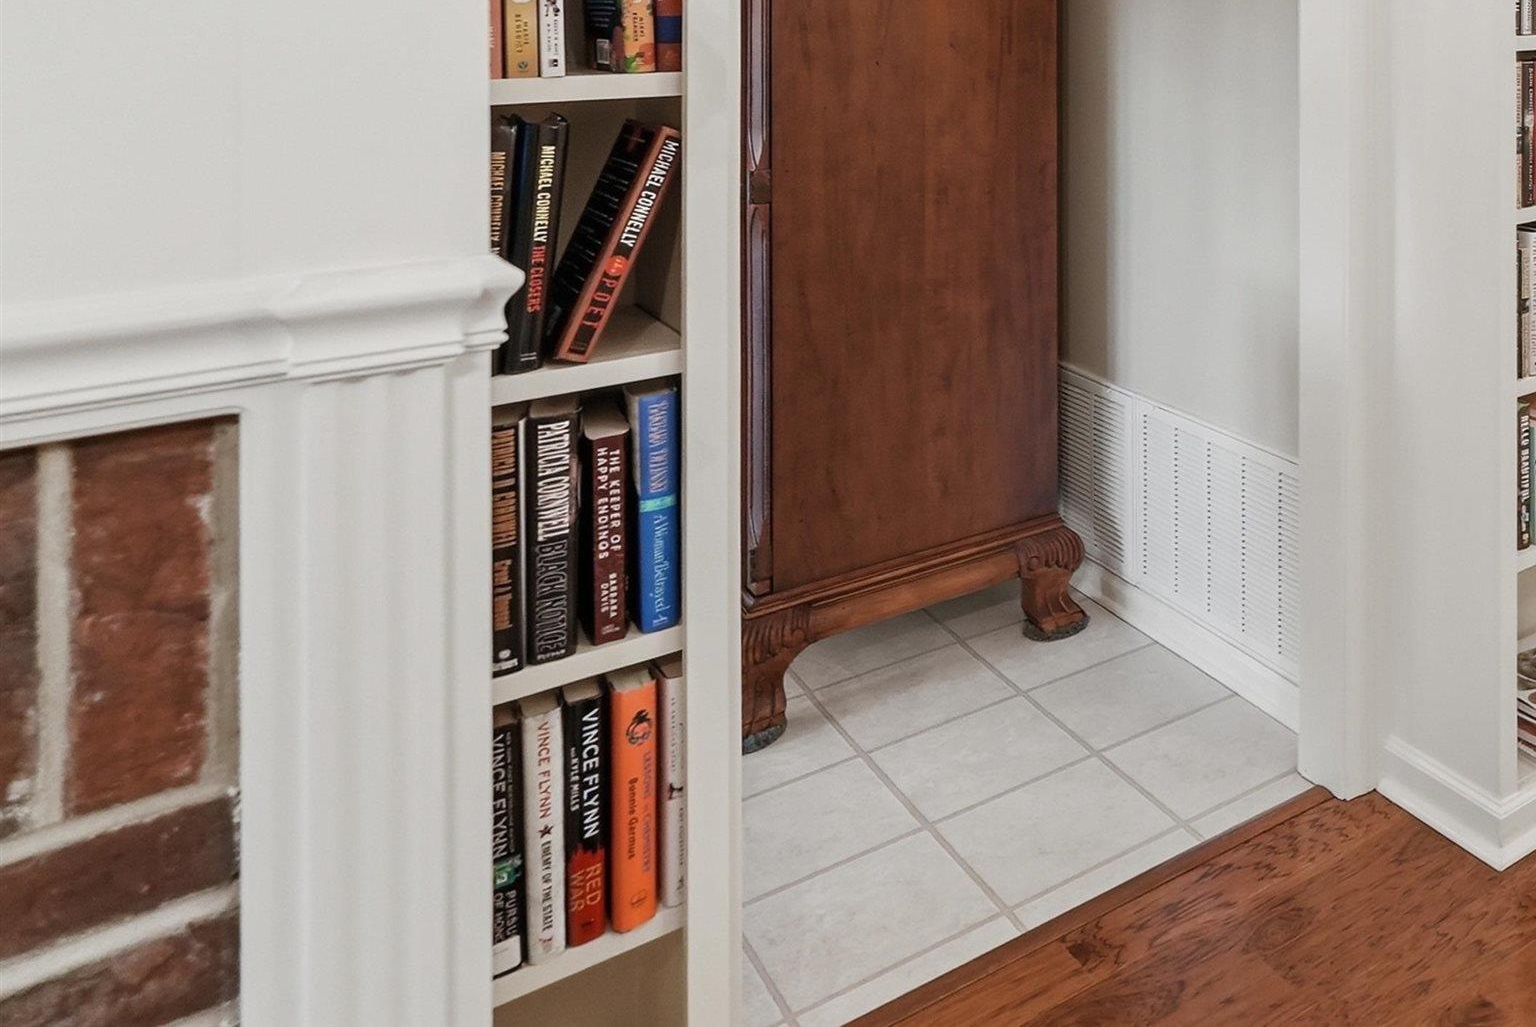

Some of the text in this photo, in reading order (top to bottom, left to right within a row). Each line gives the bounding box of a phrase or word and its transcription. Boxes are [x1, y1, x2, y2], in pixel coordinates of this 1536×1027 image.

[526, 146, 555, 313] MICHAEL CONNELLY THE CLOSERS
[620, 140, 680, 248] MICHAEL CONNELLY
[597, 447, 609, 560] HAPPY ENDINGS
[610, 449, 621, 552] THE KEEPER OF
[1520, 415, 1529, 502] HELLO BEAUTIFUL
[535, 420, 570, 652] PATRICIA CORNWELL BLACK NOTICE
[493, 734, 509, 860] VINCE FLYNN
[537, 722, 553, 932] VINCE FLYNN ENEMY OF THE STATE
[569, 758, 581, 812] KYLE MILLS
[581, 708, 600, 839] VINCE FLYNN
[626, 777, 638, 816] Bonnie
[569, 871, 584, 912] WAR
[587, 865, 601, 905] RED
